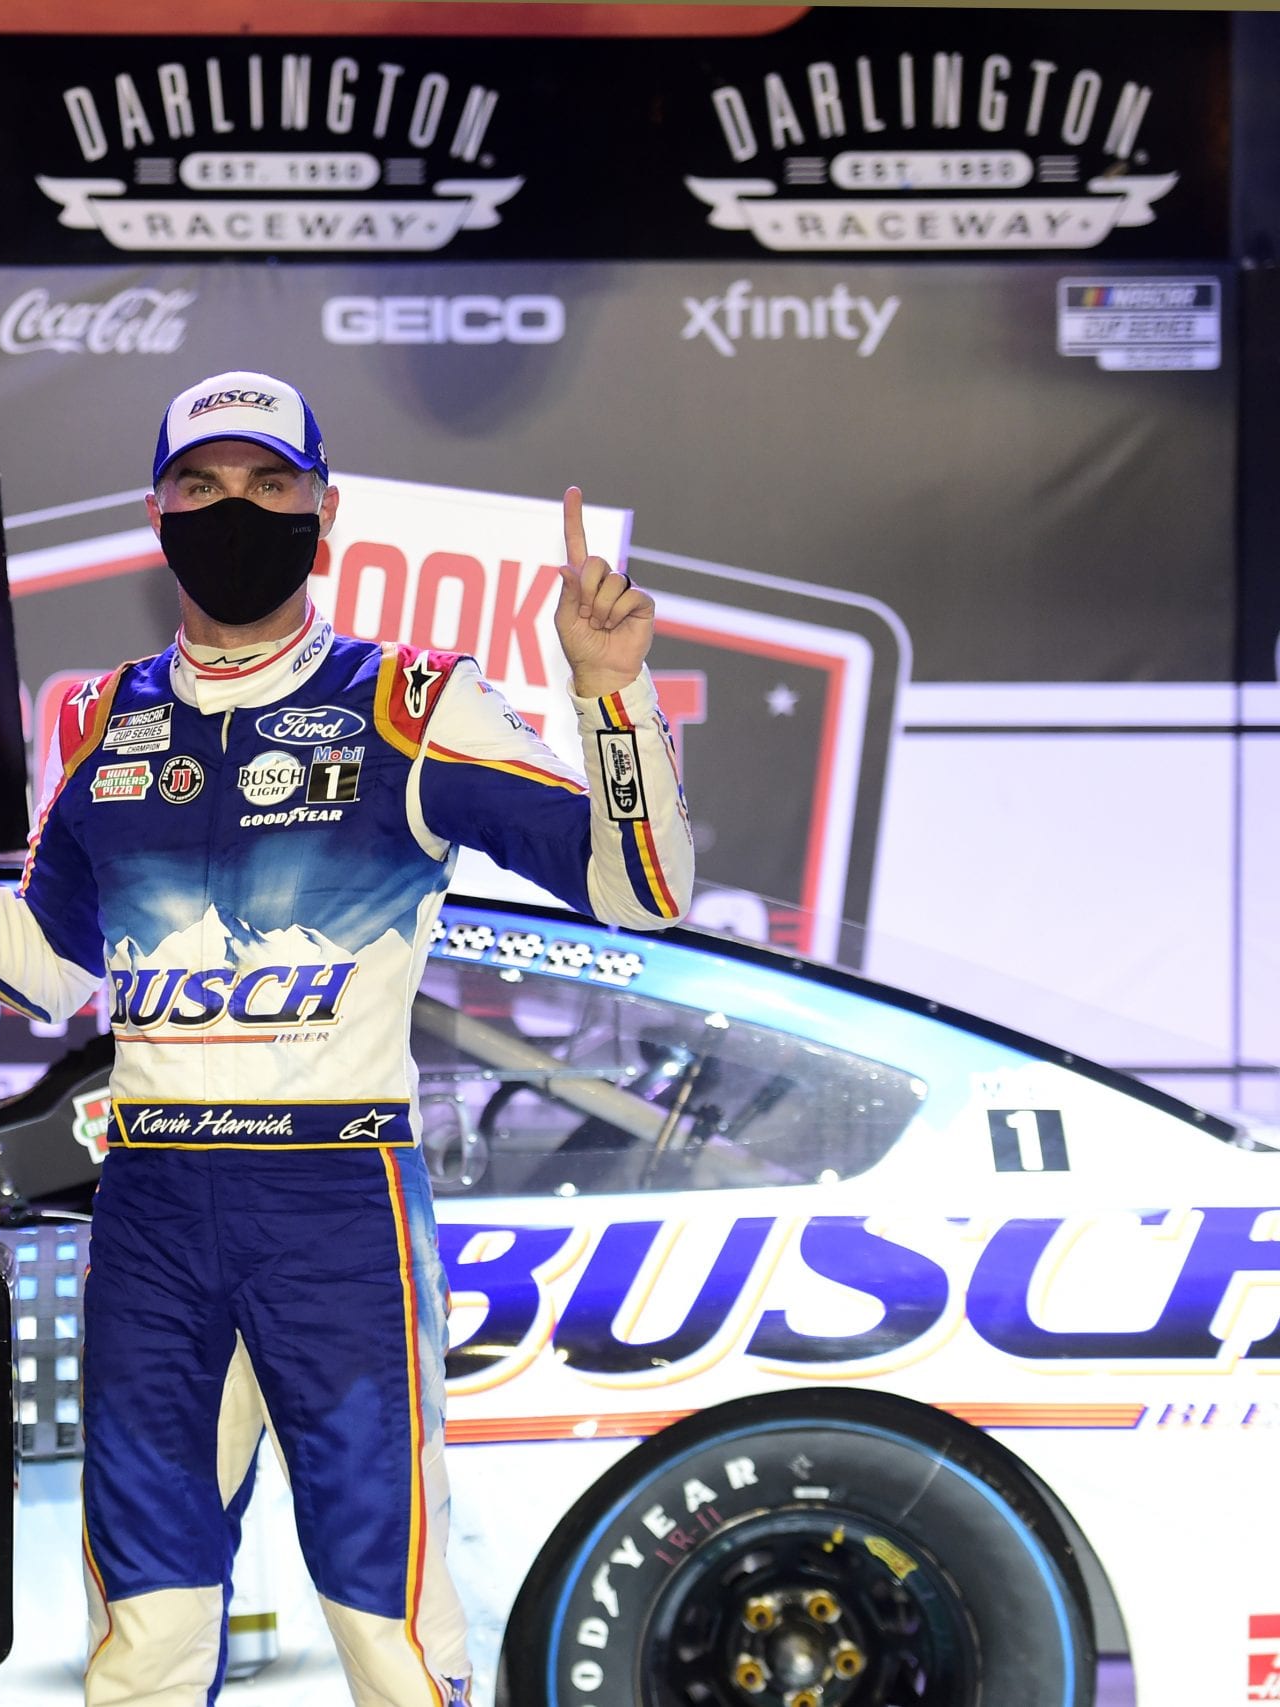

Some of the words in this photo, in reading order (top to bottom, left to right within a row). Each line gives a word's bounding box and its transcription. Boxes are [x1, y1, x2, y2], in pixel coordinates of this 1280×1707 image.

[63, 54, 498, 162] DARLINGTON
[712, 52, 1152, 162] DARLINGTON
[289, 162, 364, 181] 1950
[143, 211, 418, 240] RACEWAY
[799, 211, 1071, 239] RACEWAY
[322, 296, 566, 345] GEICO
[681, 280, 901, 356] xfinity
[188, 390, 280, 417] BUSCH
[310, 539, 562, 688] OOK
[129, 708, 165, 726] NASCAR
[274, 711, 344, 738] Ford
[113, 730, 132, 742] CUP
[133, 725, 163, 738] SERIES
[127, 743, 160, 753] CHAMPION
[314, 746, 364, 762] Mobil
[95, 776, 147, 788] BROTHERS
[105, 768, 137, 778] HUNT
[170, 769, 192, 792] JJ
[239, 768, 304, 787] BUSCH
[325, 765, 341, 800] 1
[102, 786, 134, 796] PIZZA
[250, 786, 288, 797] LIGHT
[615, 786, 633, 807] sfi
[240, 807, 343, 827] GOODYEAR
[111, 962, 358, 1030] BUSCH
[279, 1031, 330, 1043] BEER
[130, 1107, 191, 1136] Kevin
[193, 1109, 291, 1136] Harvick
[1006, 1110, 1045, 1171] 1
